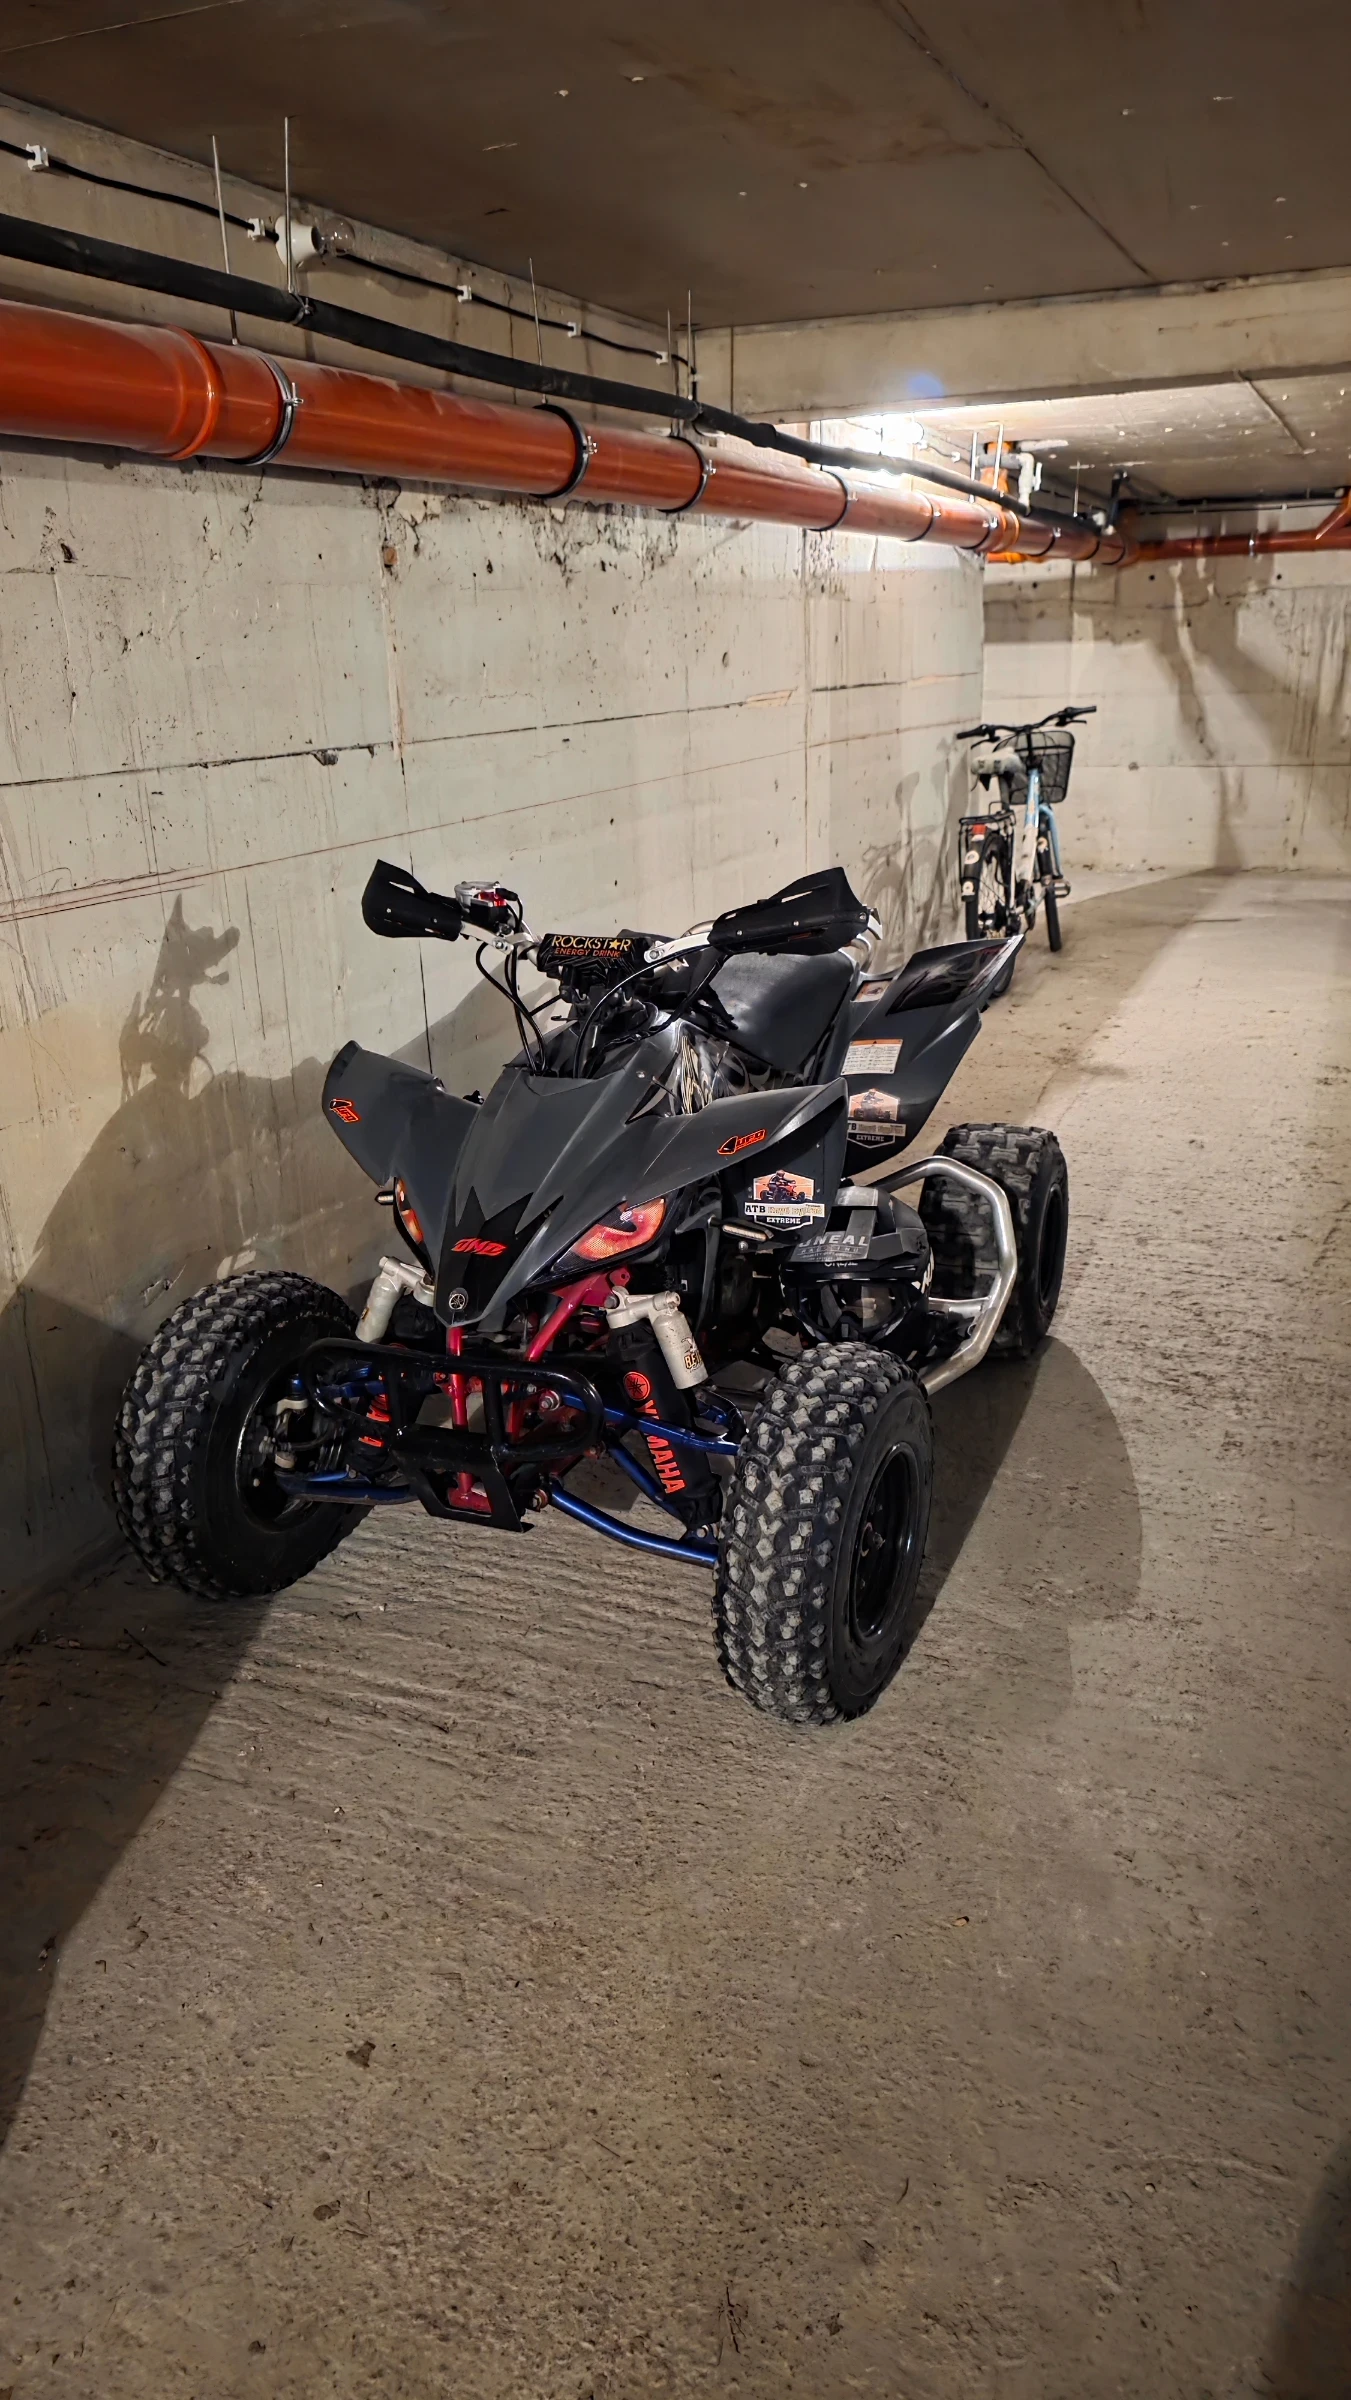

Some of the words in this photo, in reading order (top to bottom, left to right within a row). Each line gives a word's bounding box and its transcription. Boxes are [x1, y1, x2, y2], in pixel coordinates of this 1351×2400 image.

[554, 947, 590, 956] ENERGY
[592, 949, 621, 958] DRINK
[856, 1134, 885, 1142] EXTREME
[766, 1216, 801, 1225] EXTREME
[635, 1400, 686, 1494] YMAHA
